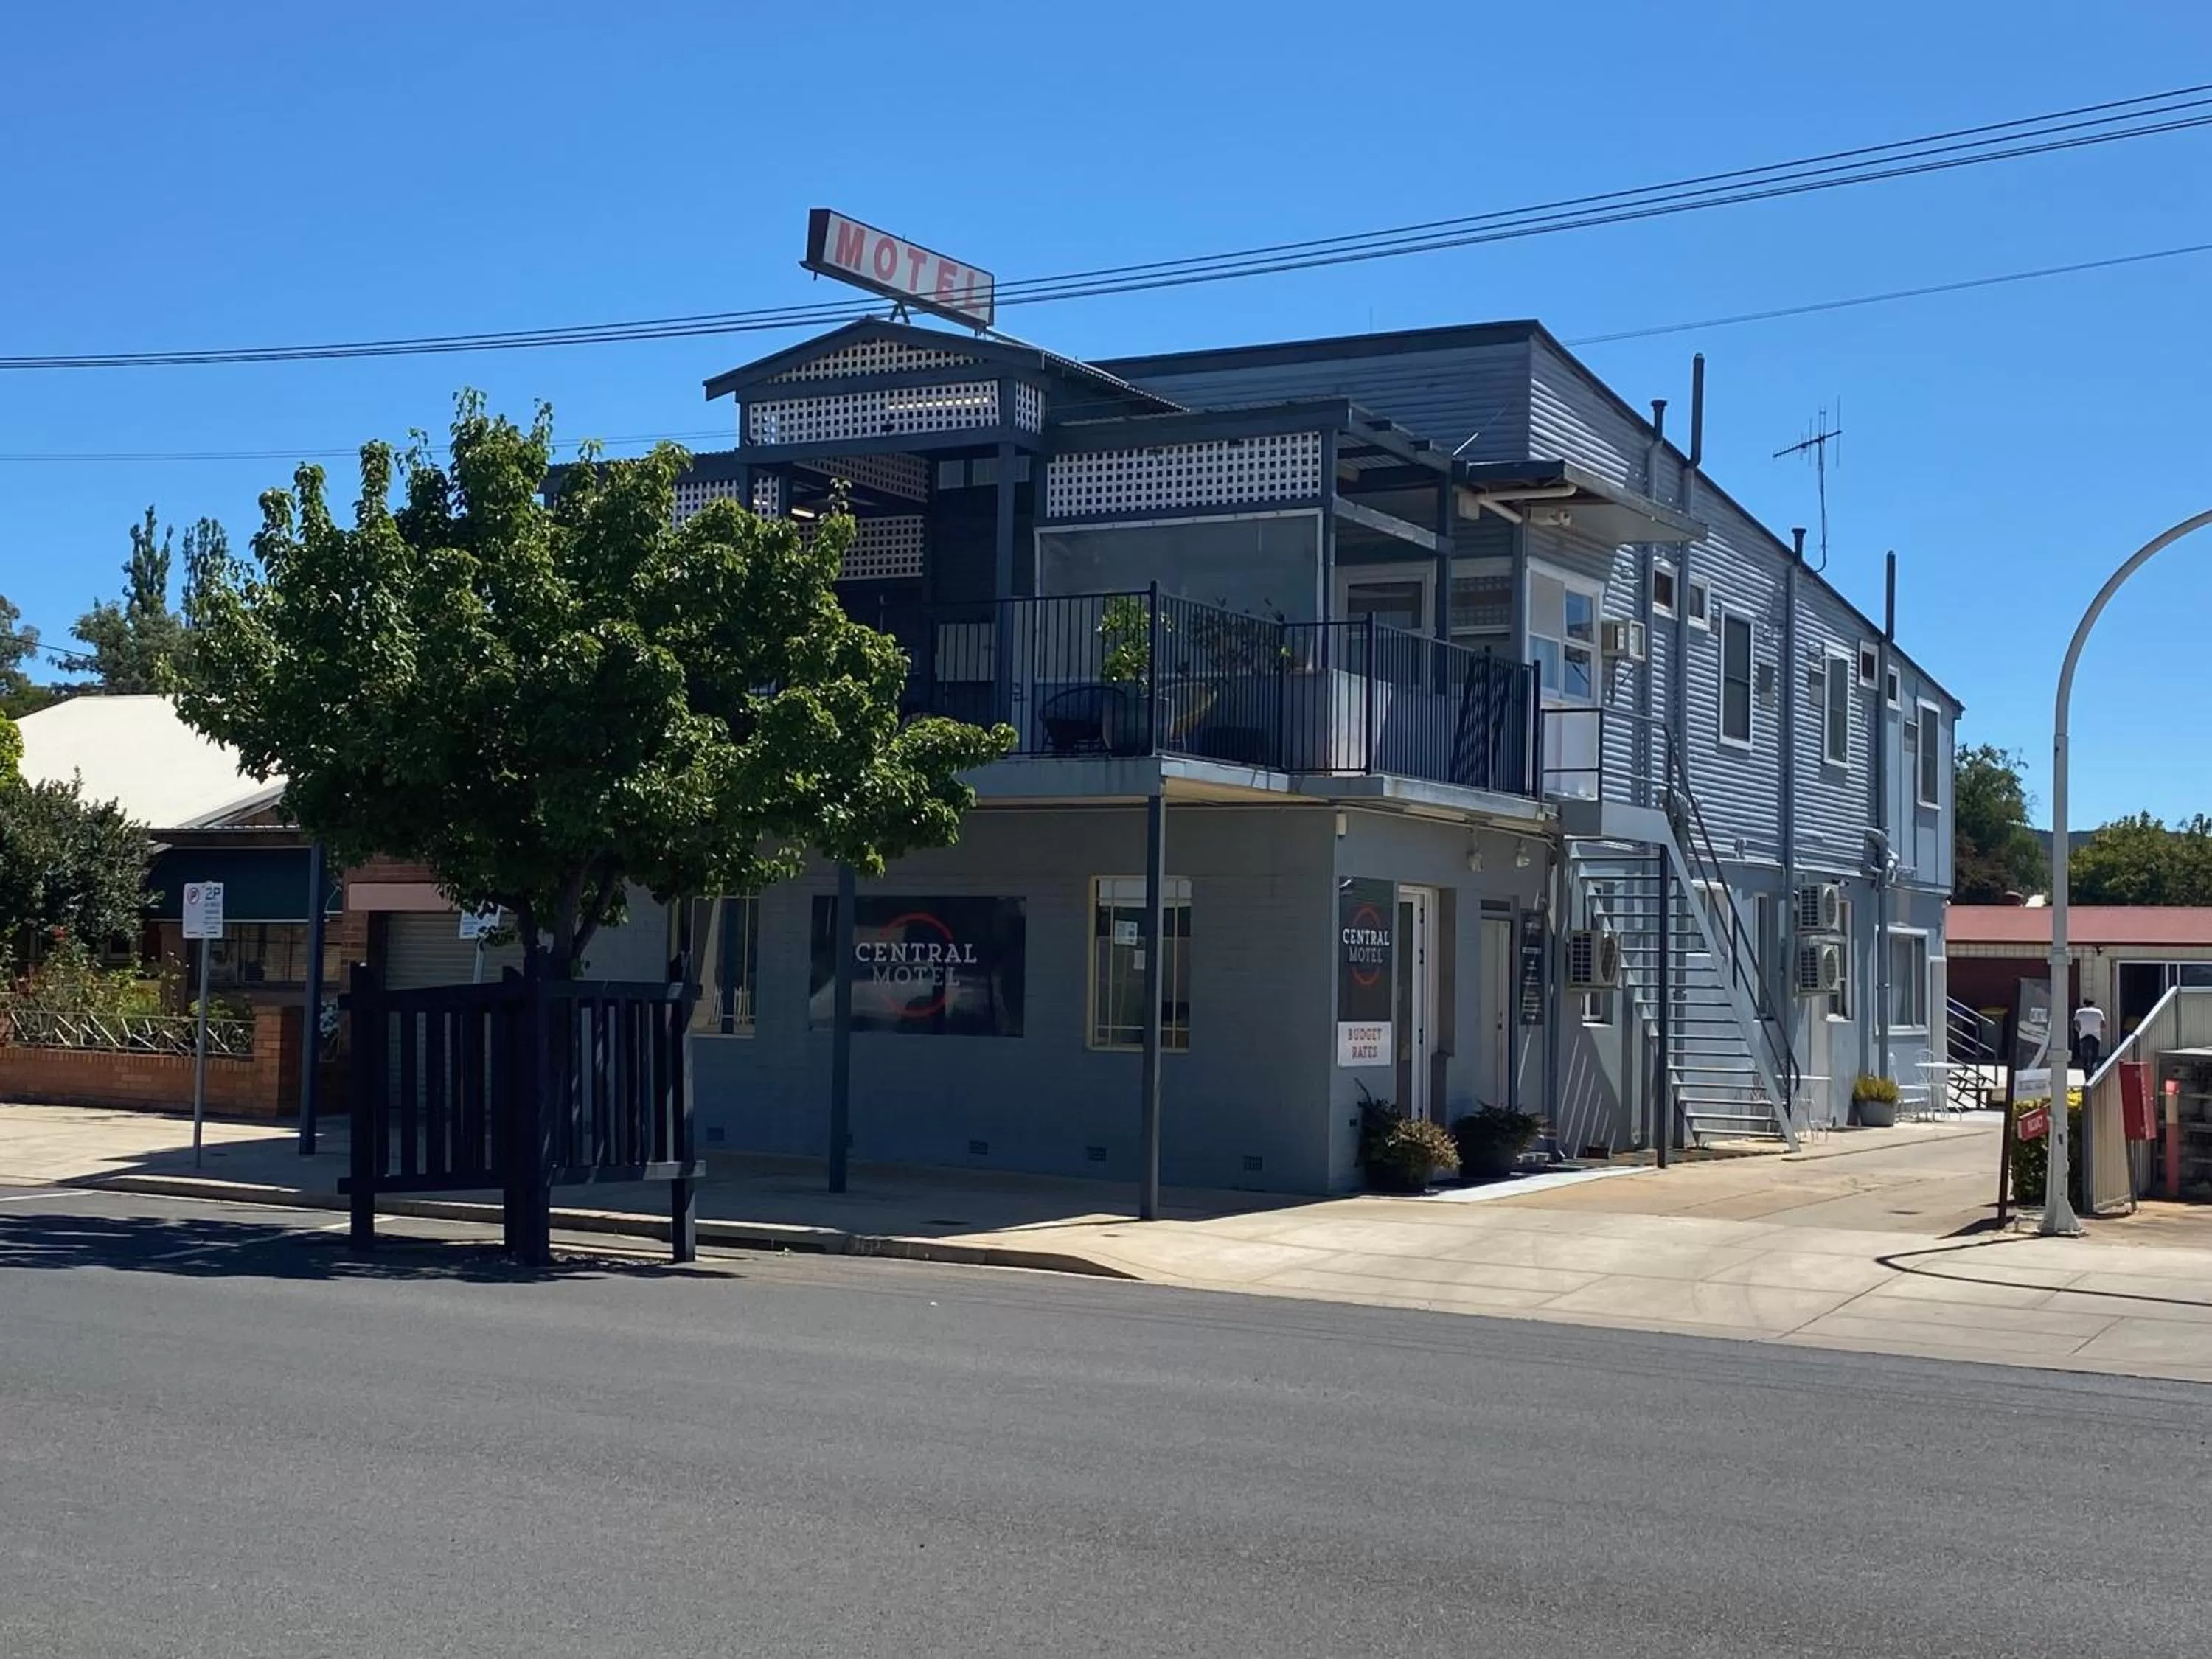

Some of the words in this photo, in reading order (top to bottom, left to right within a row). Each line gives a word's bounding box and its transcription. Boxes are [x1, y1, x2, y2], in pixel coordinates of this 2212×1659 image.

[835, 221, 981, 315] MOTEL
[205, 887, 221, 900] 2P
[1342, 928, 1390, 946] CENTRAL
[855, 942, 977, 963] CENTRAL
[1348, 946, 1383, 964] MOTEL
[872, 965, 961, 987] MOTEL
[1348, 1028, 1382, 1041] BUDGET
[1352, 1045, 1378, 1060] RATES
